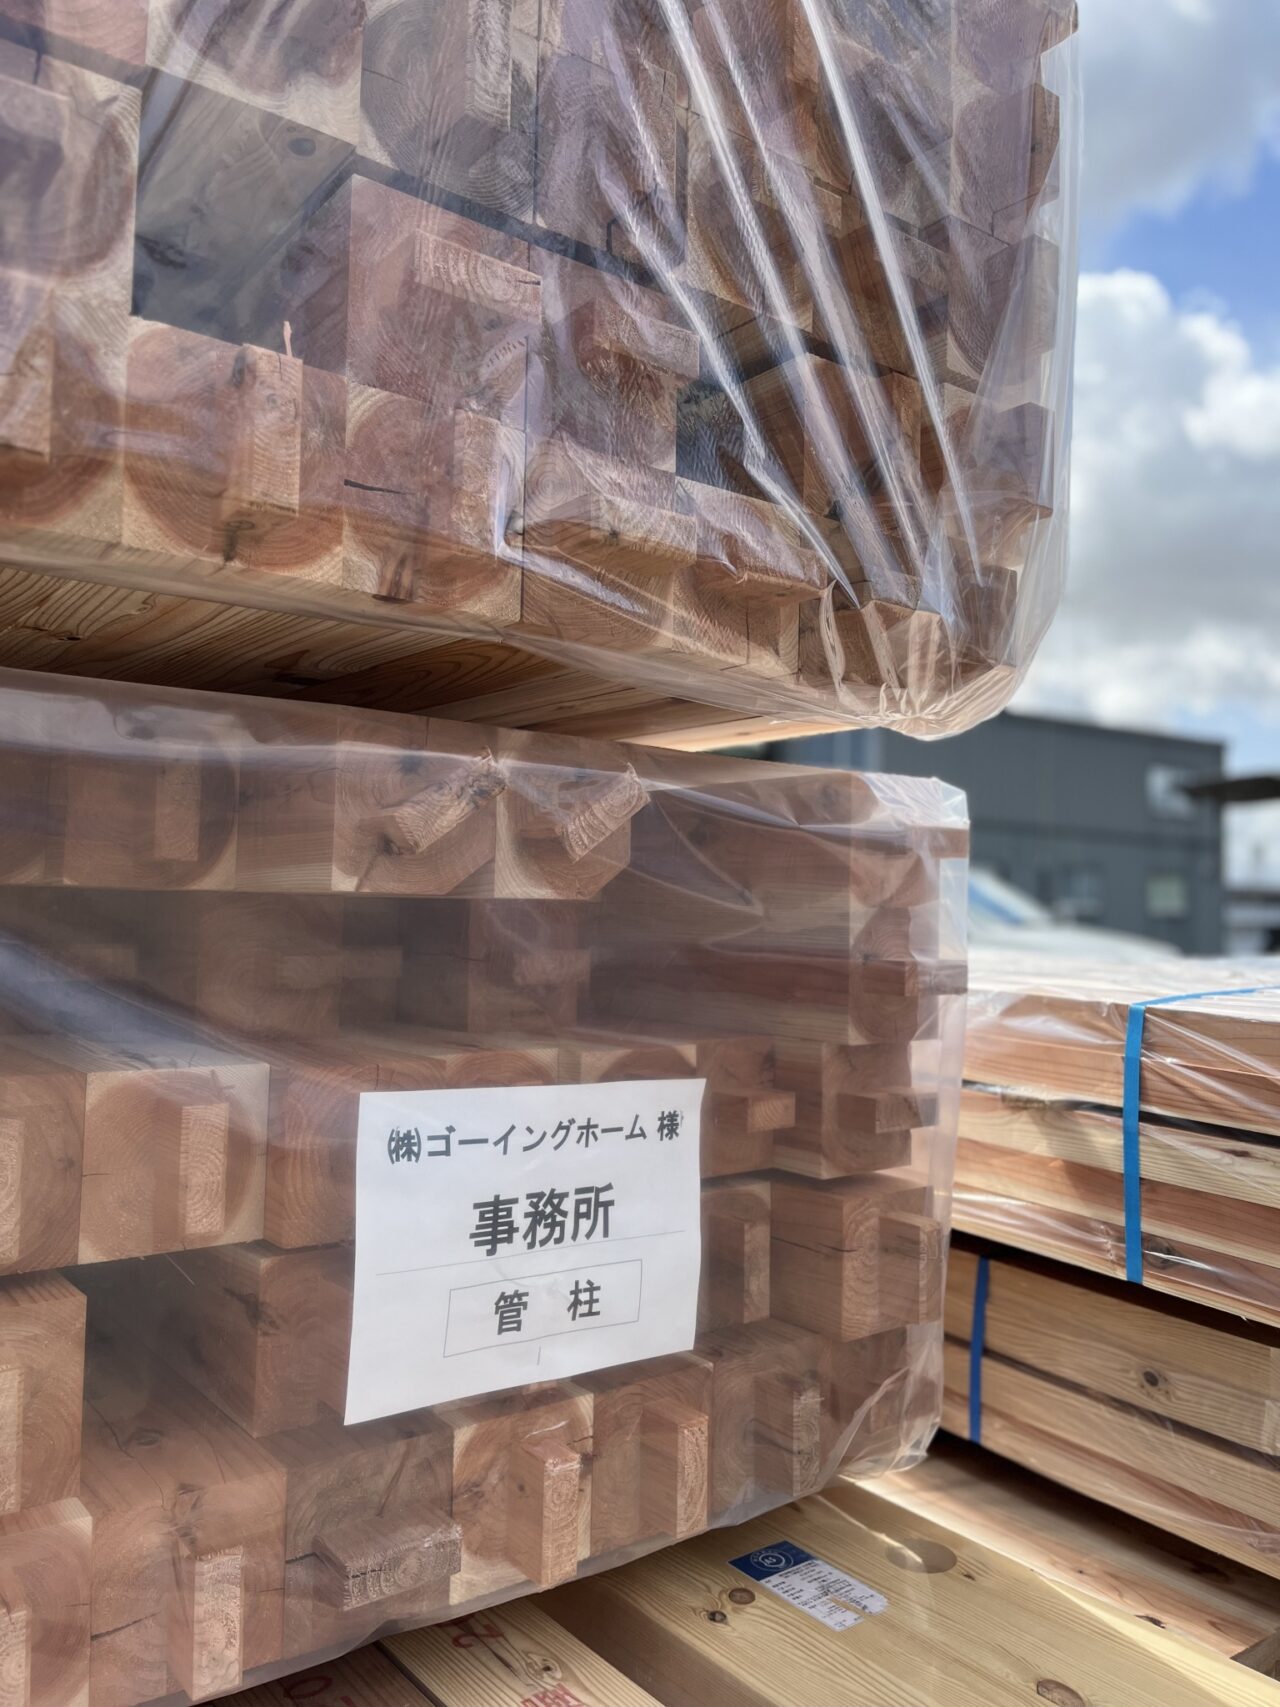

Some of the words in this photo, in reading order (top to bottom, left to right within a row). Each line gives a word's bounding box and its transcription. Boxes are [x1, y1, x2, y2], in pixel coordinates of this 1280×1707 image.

[656, 1110, 684, 1142] 様
[469, 1182, 615, 1257] 事務所
